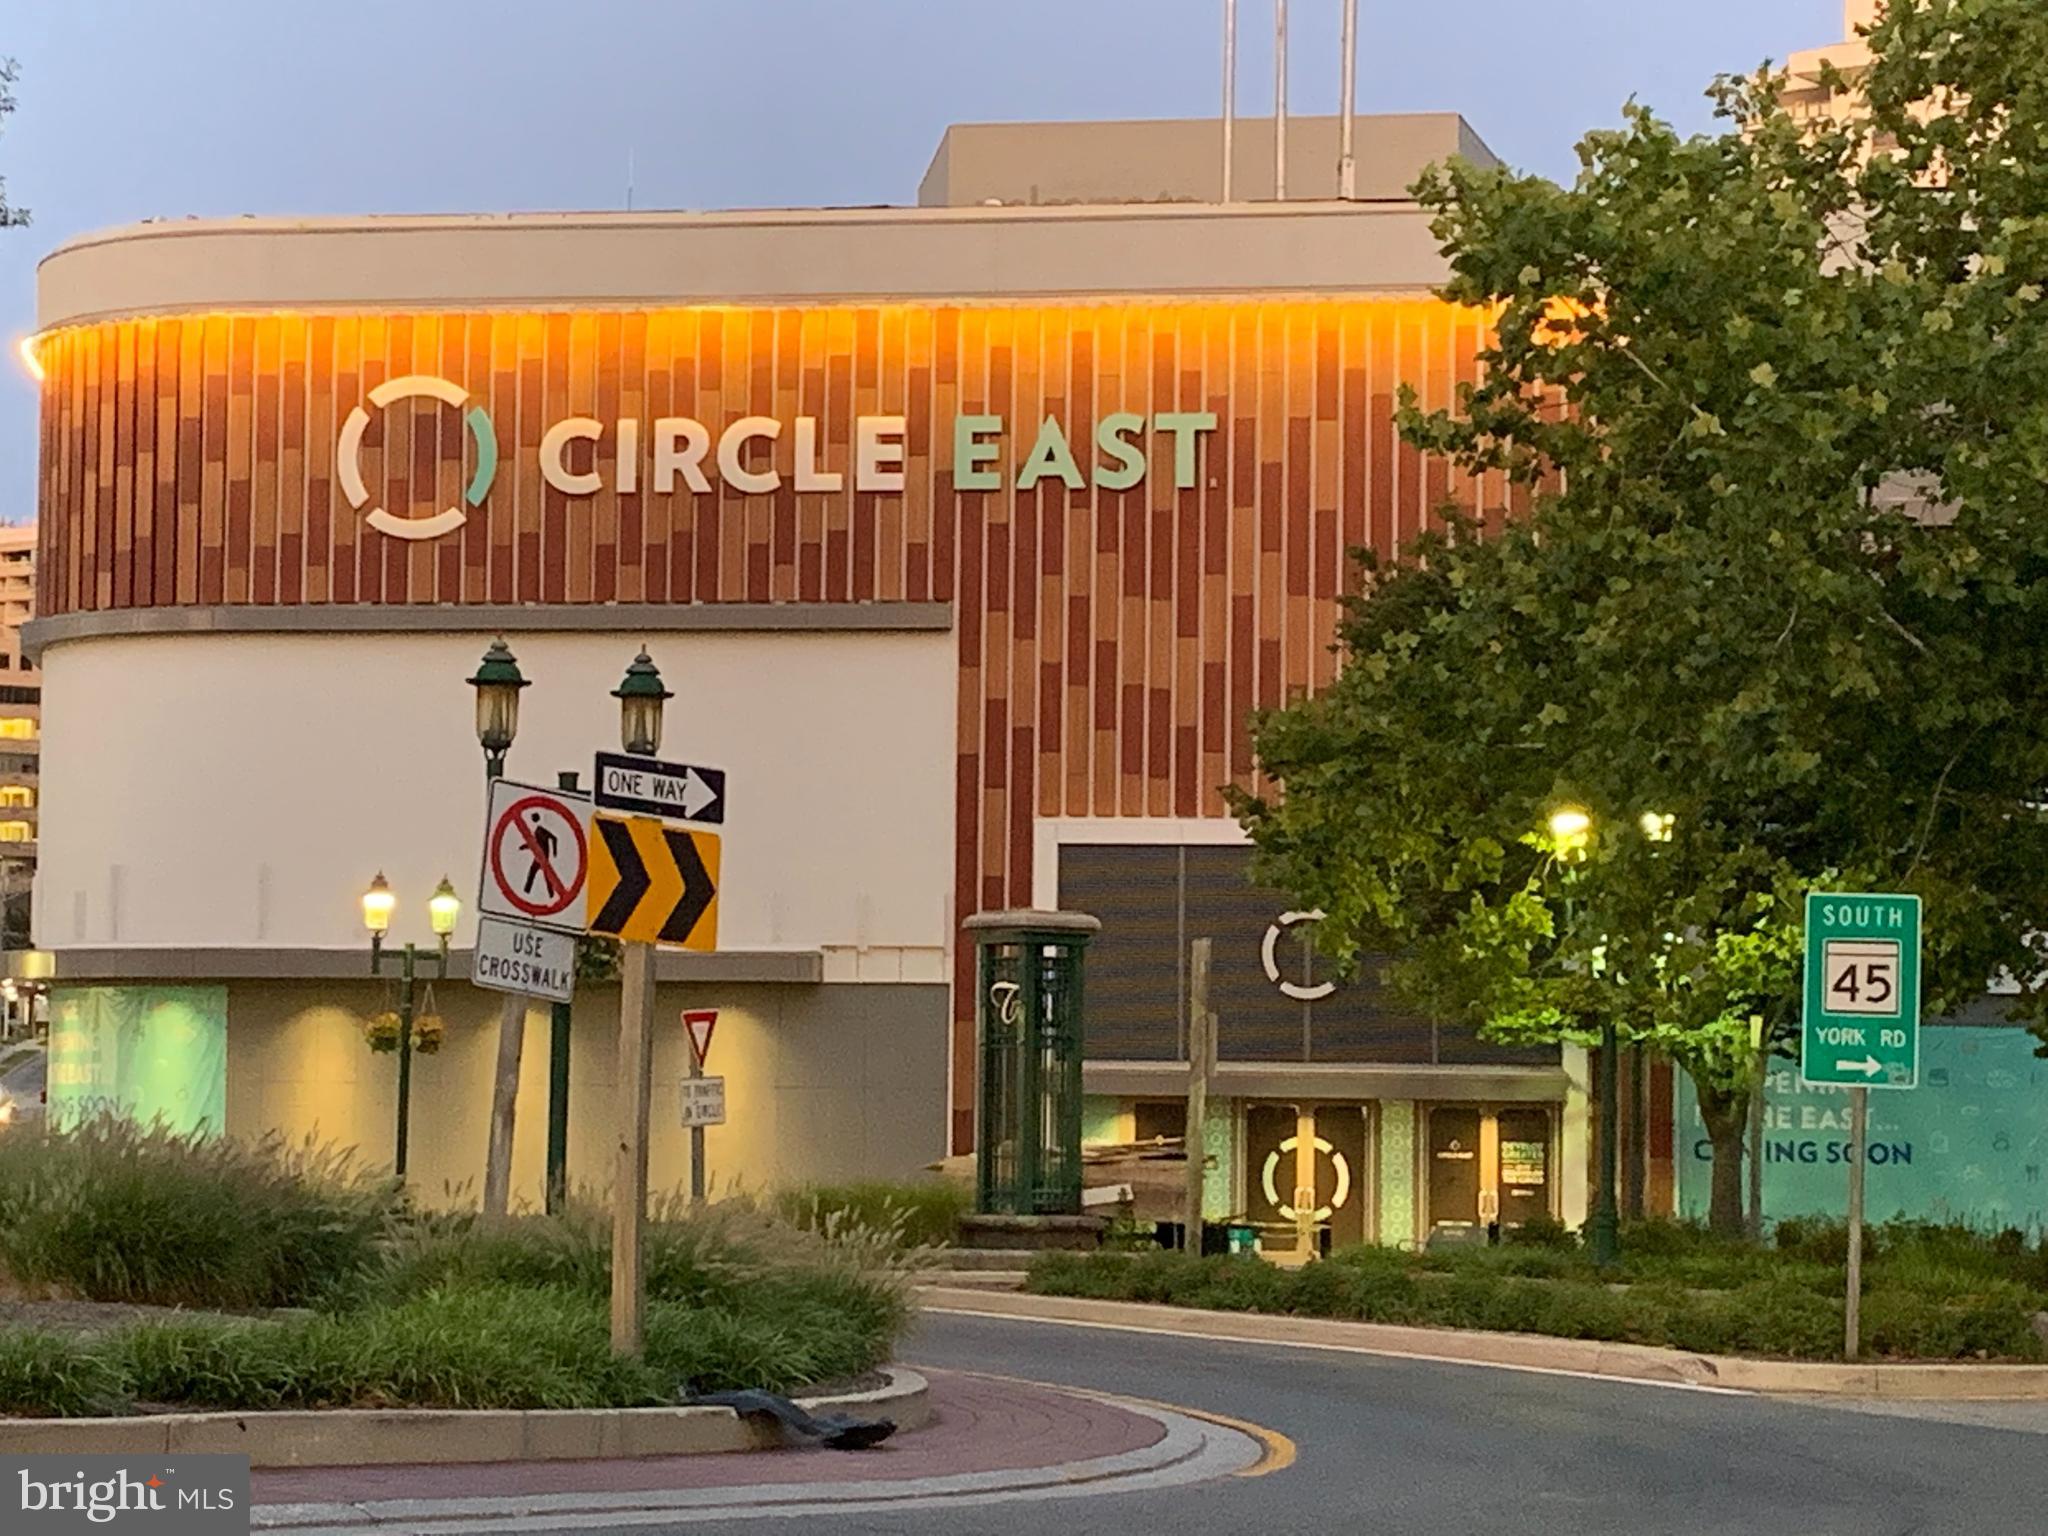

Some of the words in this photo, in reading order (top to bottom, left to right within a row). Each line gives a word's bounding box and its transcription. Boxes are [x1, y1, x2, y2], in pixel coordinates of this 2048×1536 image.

[539, 416, 907, 497] CIRCLE
[952, 412, 1218, 491] EAST
[608, 770, 643, 796] ONE
[653, 782, 687, 802] WAY
[1822, 904, 1903, 928] SOUTH
[513, 931, 543, 958] USE
[479, 955, 571, 991] CROSSWALK
[1832, 964, 1892, 1003] 45
[1815, 1027, 1866, 1047] YORK
[1880, 1028, 1906, 1048] RD
